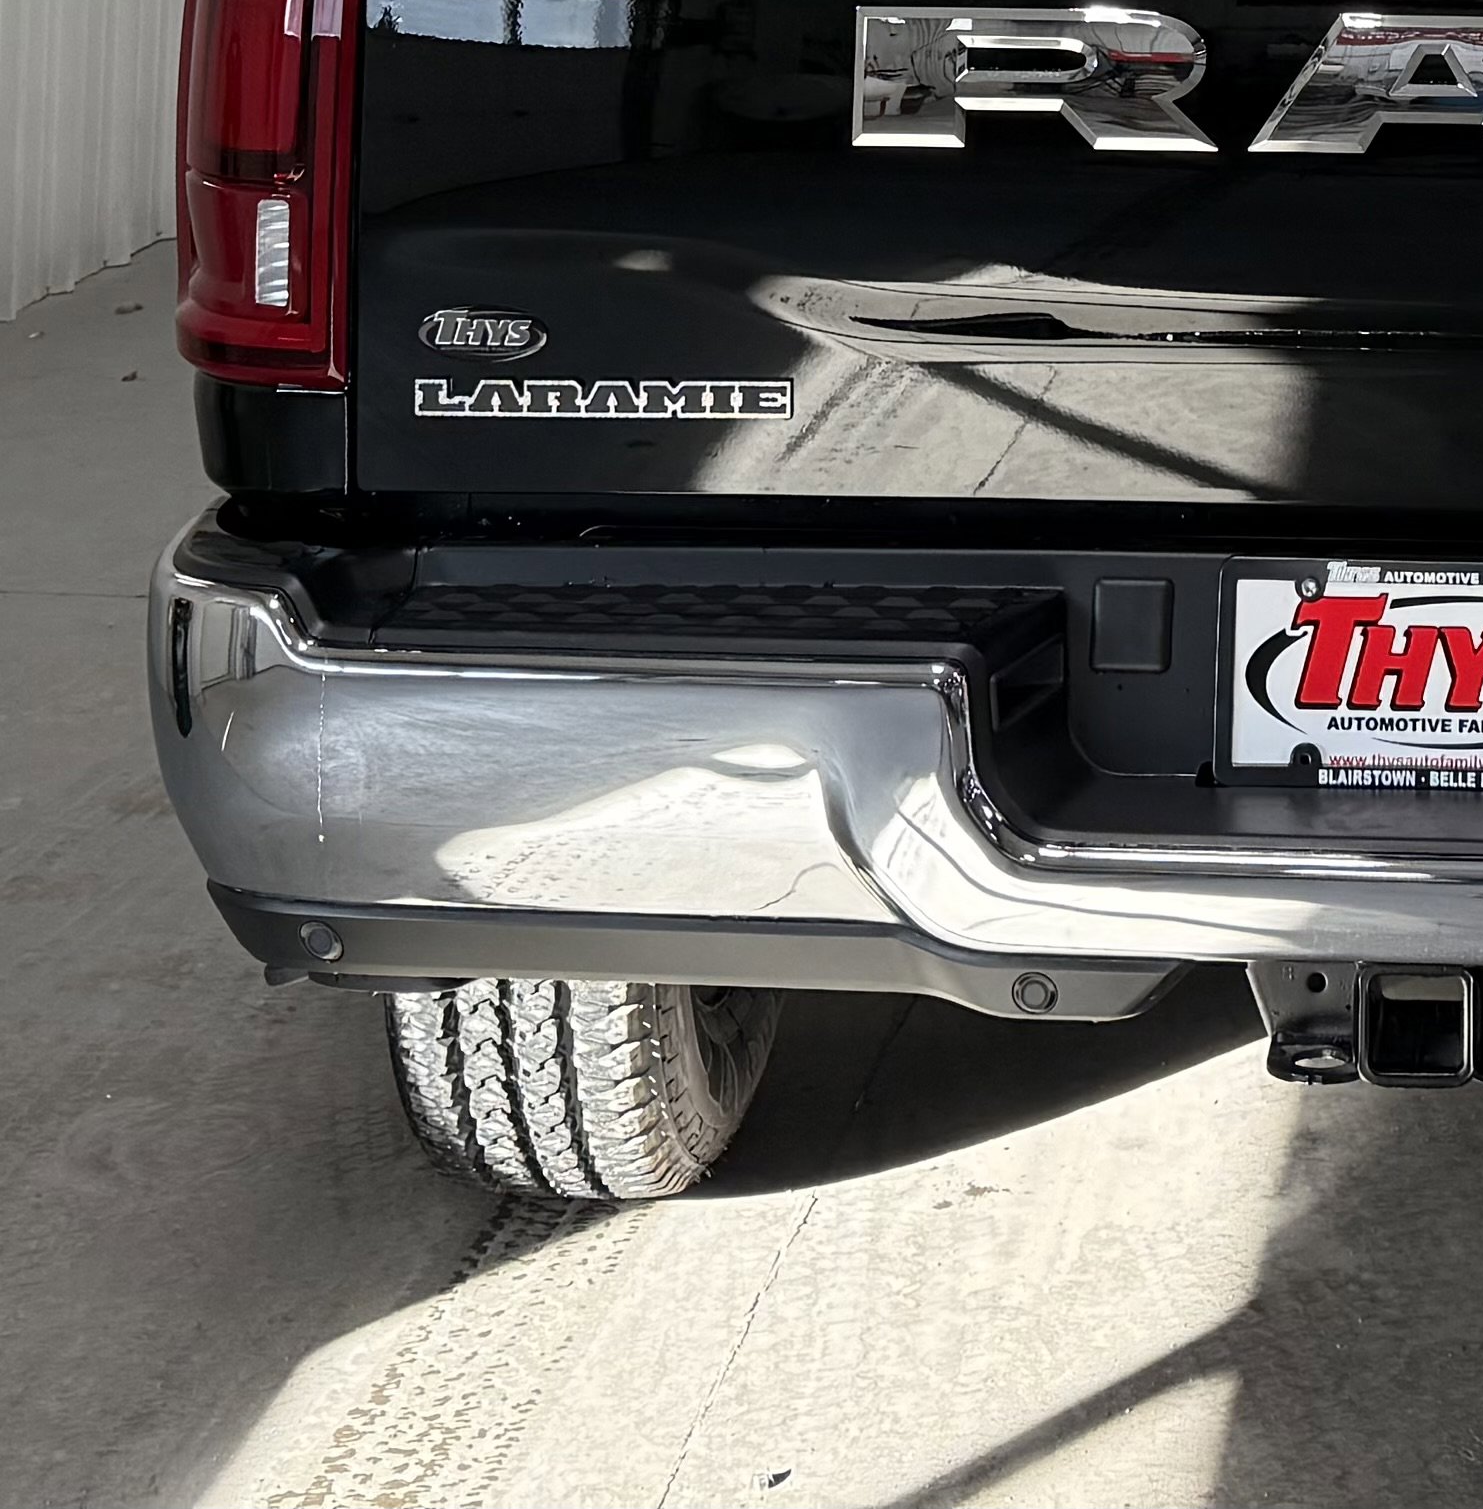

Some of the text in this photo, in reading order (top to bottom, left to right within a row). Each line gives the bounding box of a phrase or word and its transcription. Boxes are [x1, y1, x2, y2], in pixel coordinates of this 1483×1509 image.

[433, 309, 533, 347] THYS
[414, 378, 794, 419] LARAMIE
[1383, 571, 1480, 585] AUTOMOTIVE
[1326, 716, 1453, 733] AUTOMOTIVE
[1318, 768, 1416, 787] BLAIRSTOWN
[1429, 771, 1477, 788] BELLE
